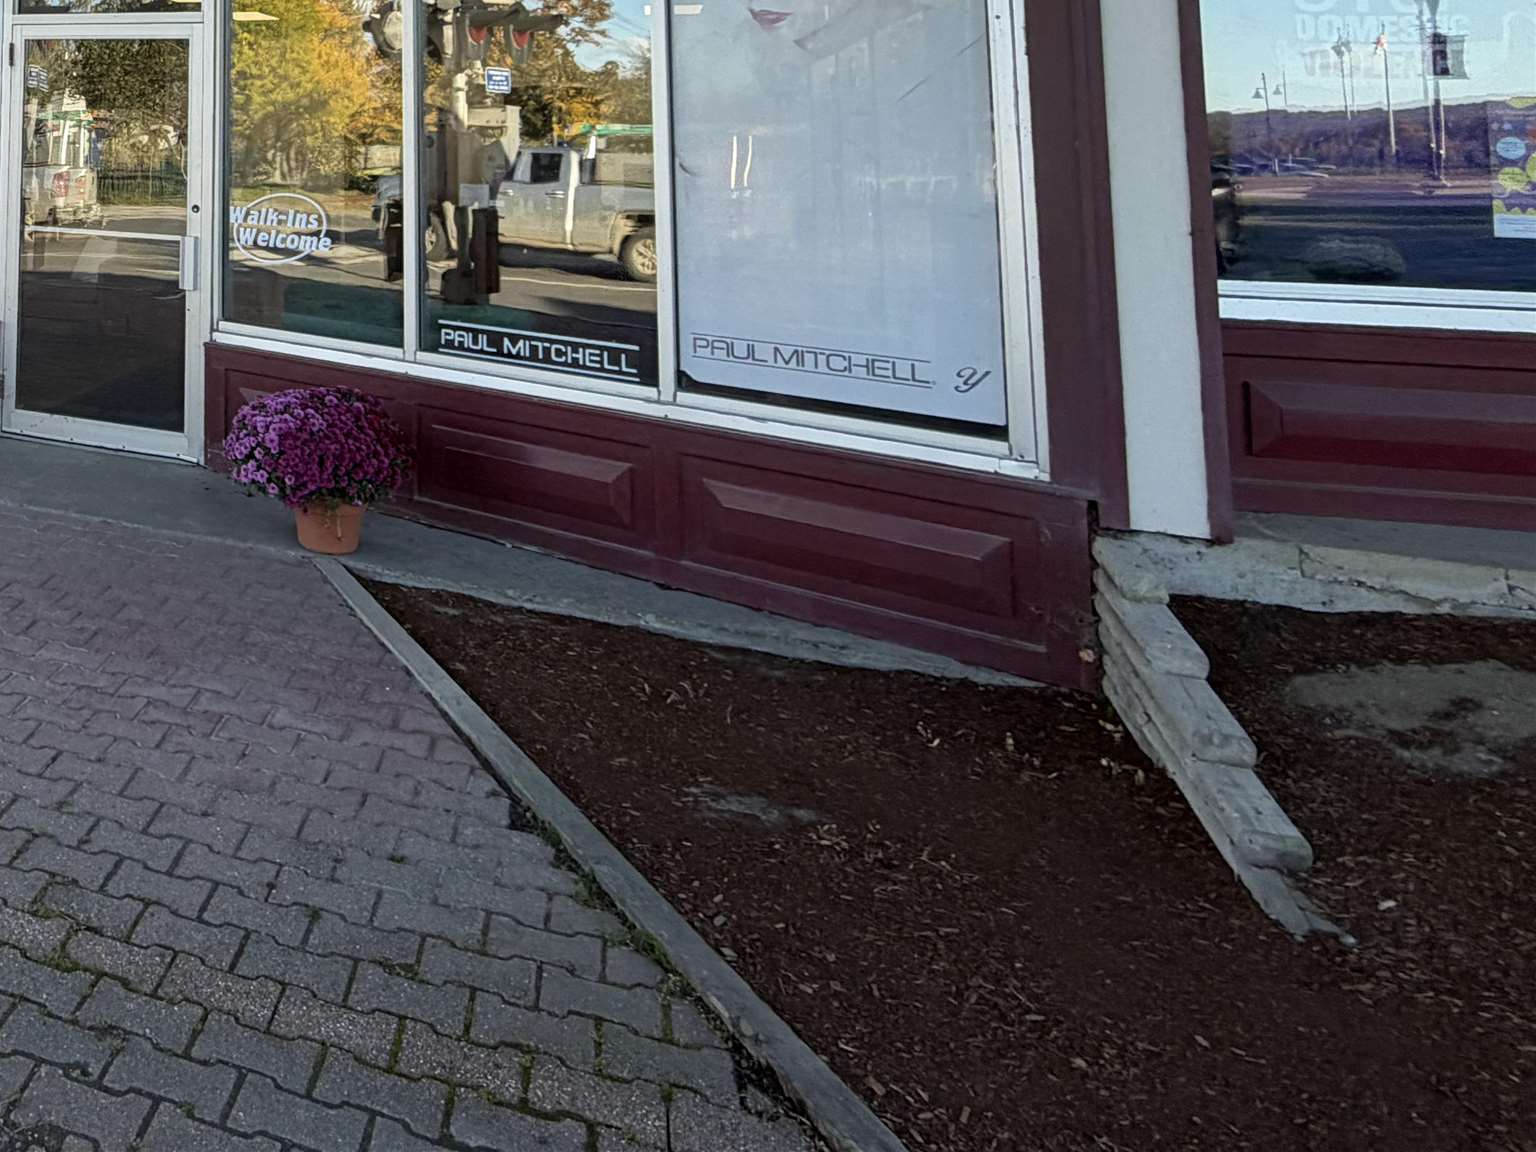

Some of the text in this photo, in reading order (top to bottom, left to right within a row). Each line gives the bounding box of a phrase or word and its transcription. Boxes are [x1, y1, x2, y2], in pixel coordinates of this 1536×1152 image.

[230, 206, 319, 229] Walk-Ins
[239, 227, 332, 252] Welcome
[440, 328, 638, 374] PAUL MITCHELL
[692, 336, 768, 363] PAUL
[773, 346, 931, 385] MITCHELL
